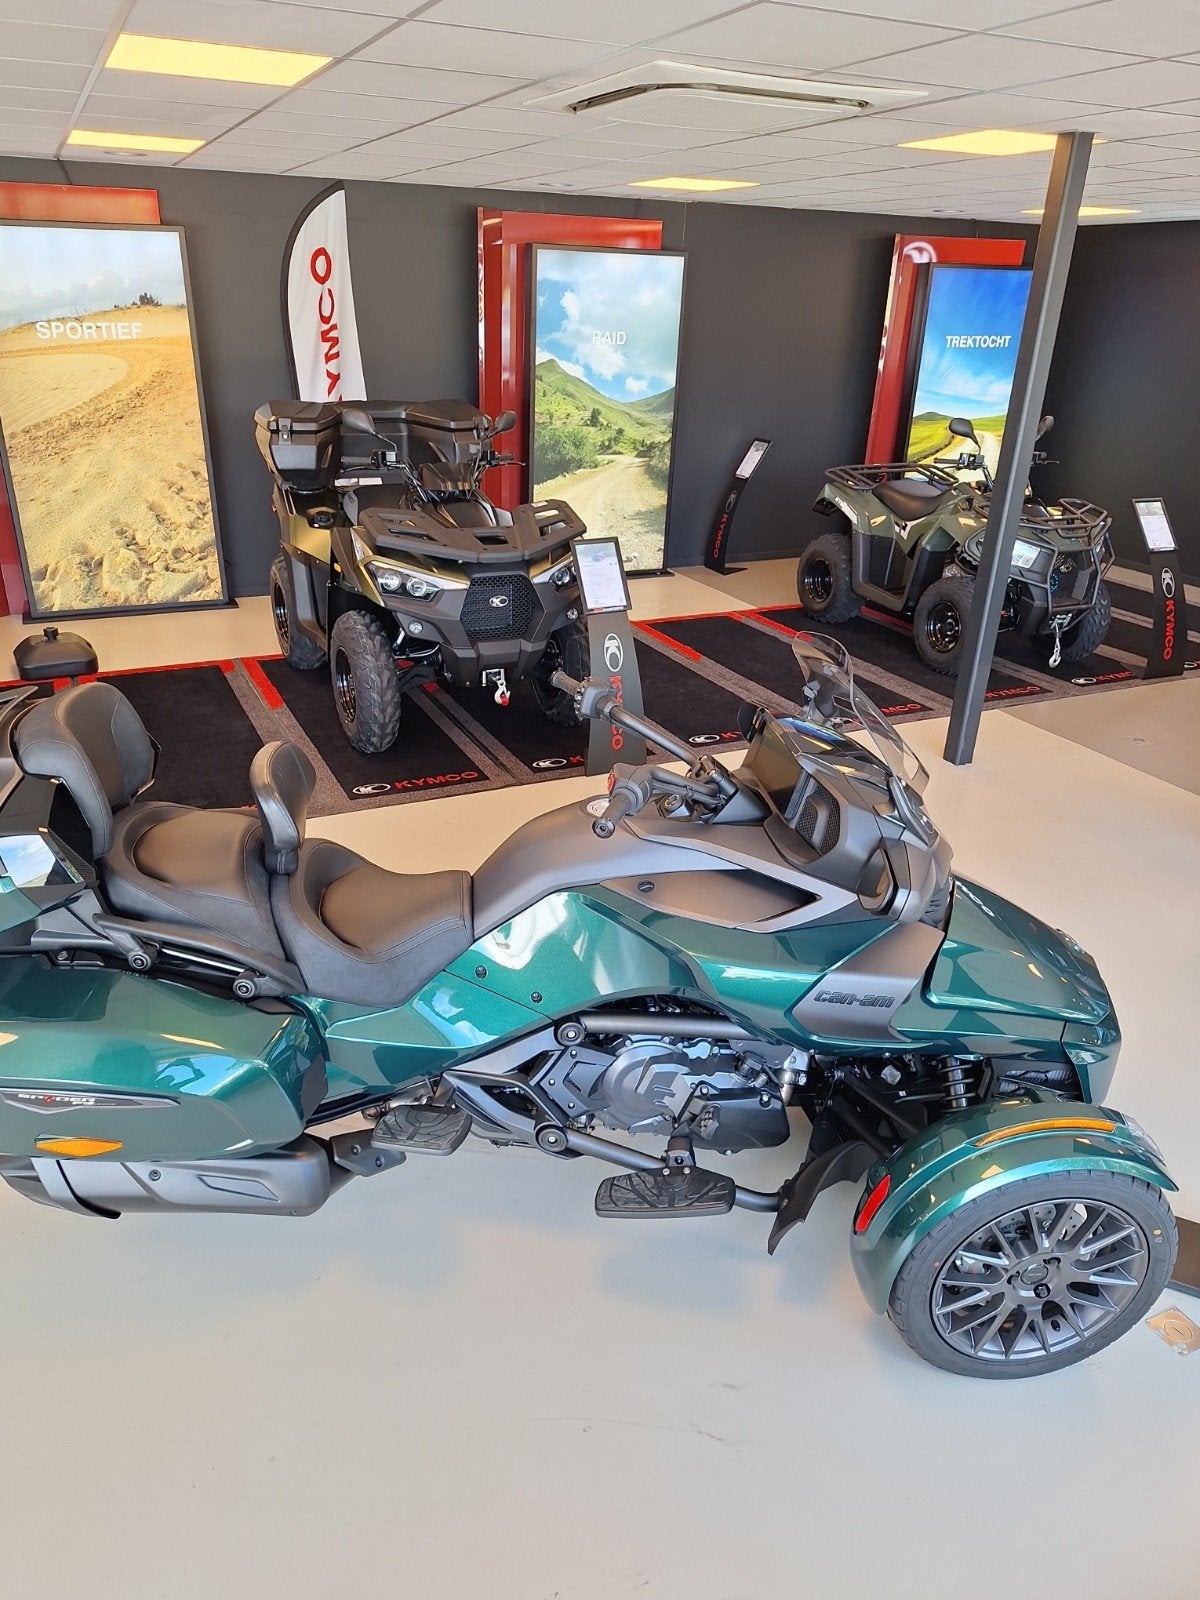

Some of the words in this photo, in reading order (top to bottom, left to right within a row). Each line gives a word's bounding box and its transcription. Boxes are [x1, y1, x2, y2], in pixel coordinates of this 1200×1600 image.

[35, 321, 143, 340] SPORTIEF
[310, 247, 342, 402] YMCO
[592, 330, 627, 345] RAID
[945, 335, 1012, 348] TREKTOCHT
[713, 513, 729, 558] KYMCO
[1163, 600, 1175, 660] KYMCO
[394, 771, 479, 790] KYMCO
